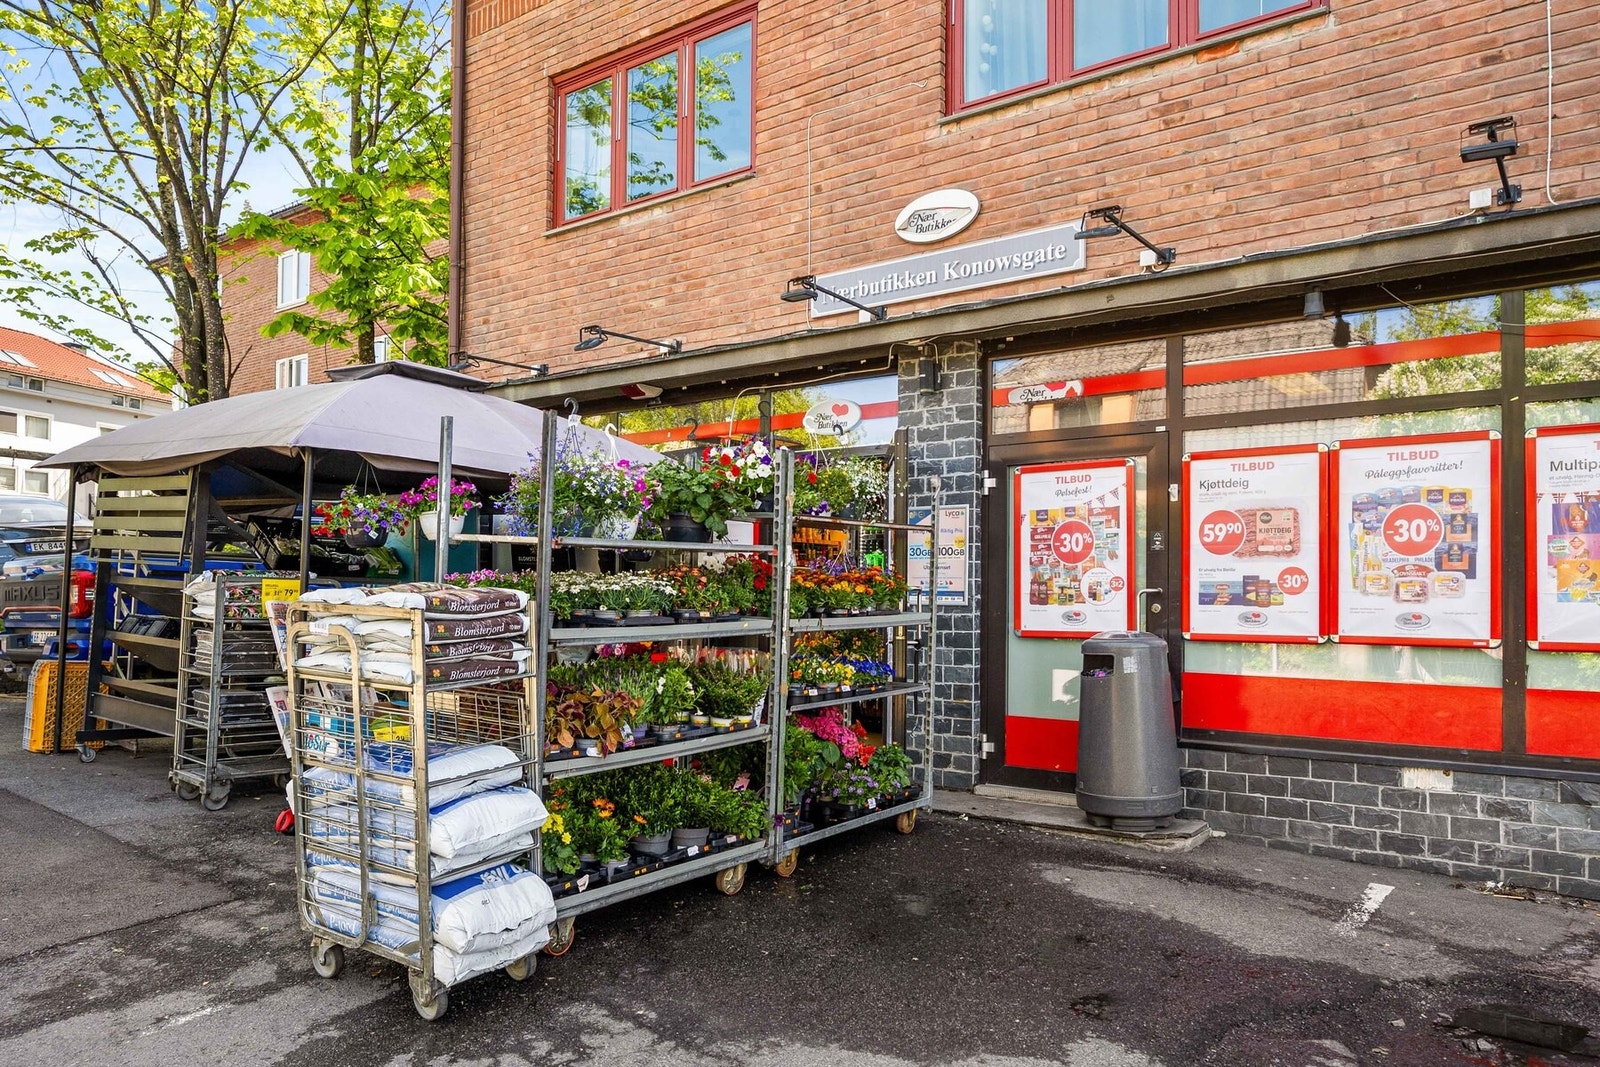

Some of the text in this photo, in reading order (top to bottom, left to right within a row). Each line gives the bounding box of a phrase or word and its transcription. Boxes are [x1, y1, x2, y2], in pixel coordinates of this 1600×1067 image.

[908, 212, 937, 227] Nær
[821, 241, 1067, 305] Nærbutikken Konowsgate
[1020, 388, 1045, 401] Nær
[817, 419, 848, 430] Butikken
[1387, 450, 1440, 462] TILBUD
[1231, 461, 1275, 472] TILBUD
[1365, 460, 1464, 479] Påleggsfavoritter!
[1550, 458, 1600, 473] Multip
[1055, 474, 1092, 485] TILBUD
[1199, 478, 1249, 491] Kjøttdeig
[1386, 519, 1440, 543] -30%
[33, 543, 45, 551] EK
[1054, 532, 1093, 553] -30%
[1279, 574, 1308, 588] -30%
[4, 585, 60, 601] MAXUS
[449, 600, 500, 612] Blomsterjord
[454, 623, 504, 637] Blomsterjord
[449, 666, 501, 680] Blomsterjord
